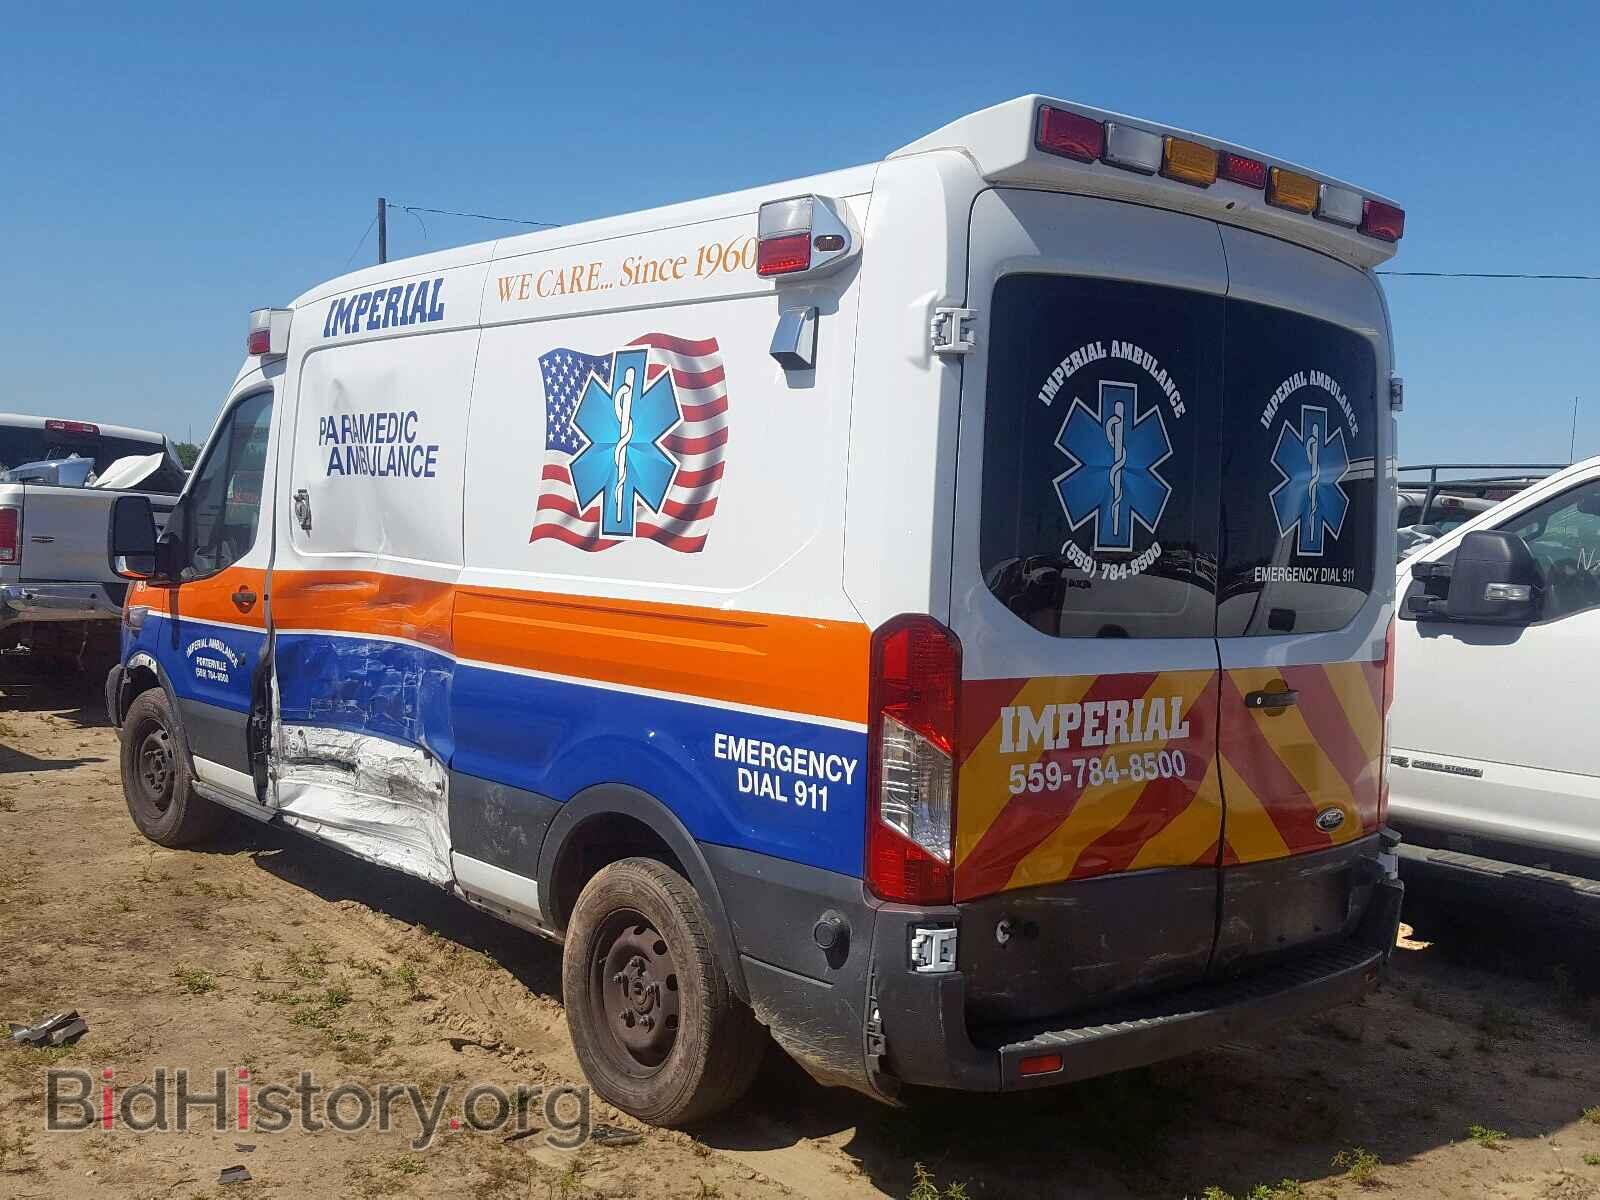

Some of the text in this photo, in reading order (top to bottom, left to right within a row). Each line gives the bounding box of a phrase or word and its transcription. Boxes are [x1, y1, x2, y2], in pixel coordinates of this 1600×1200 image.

[497, 233, 758, 304] WE CARE... Since 1960
[323, 277, 445, 338] IMPERIAL
[1038, 339, 1187, 419] IMPERIAL AMBULANCE
[1260, 369, 1359, 439] IMPERIAL AMBULANCE
[319, 410, 418, 446] PARAMEDIC
[327, 444, 439, 478] AMBULANCE
[1061, 539, 1162, 581] (559) 784-8500
[1254, 566, 1355, 583] EMERGENCY DIAL 911
[186, 638, 239, 668] IMPERIAL AMBULANCE
[999, 696, 1190, 753] IMPERIAL
[714, 732, 858, 785] EMERGENCY
[1008, 750, 1187, 794] 559-784-8500
[738, 767, 828, 812] DIAL 911
